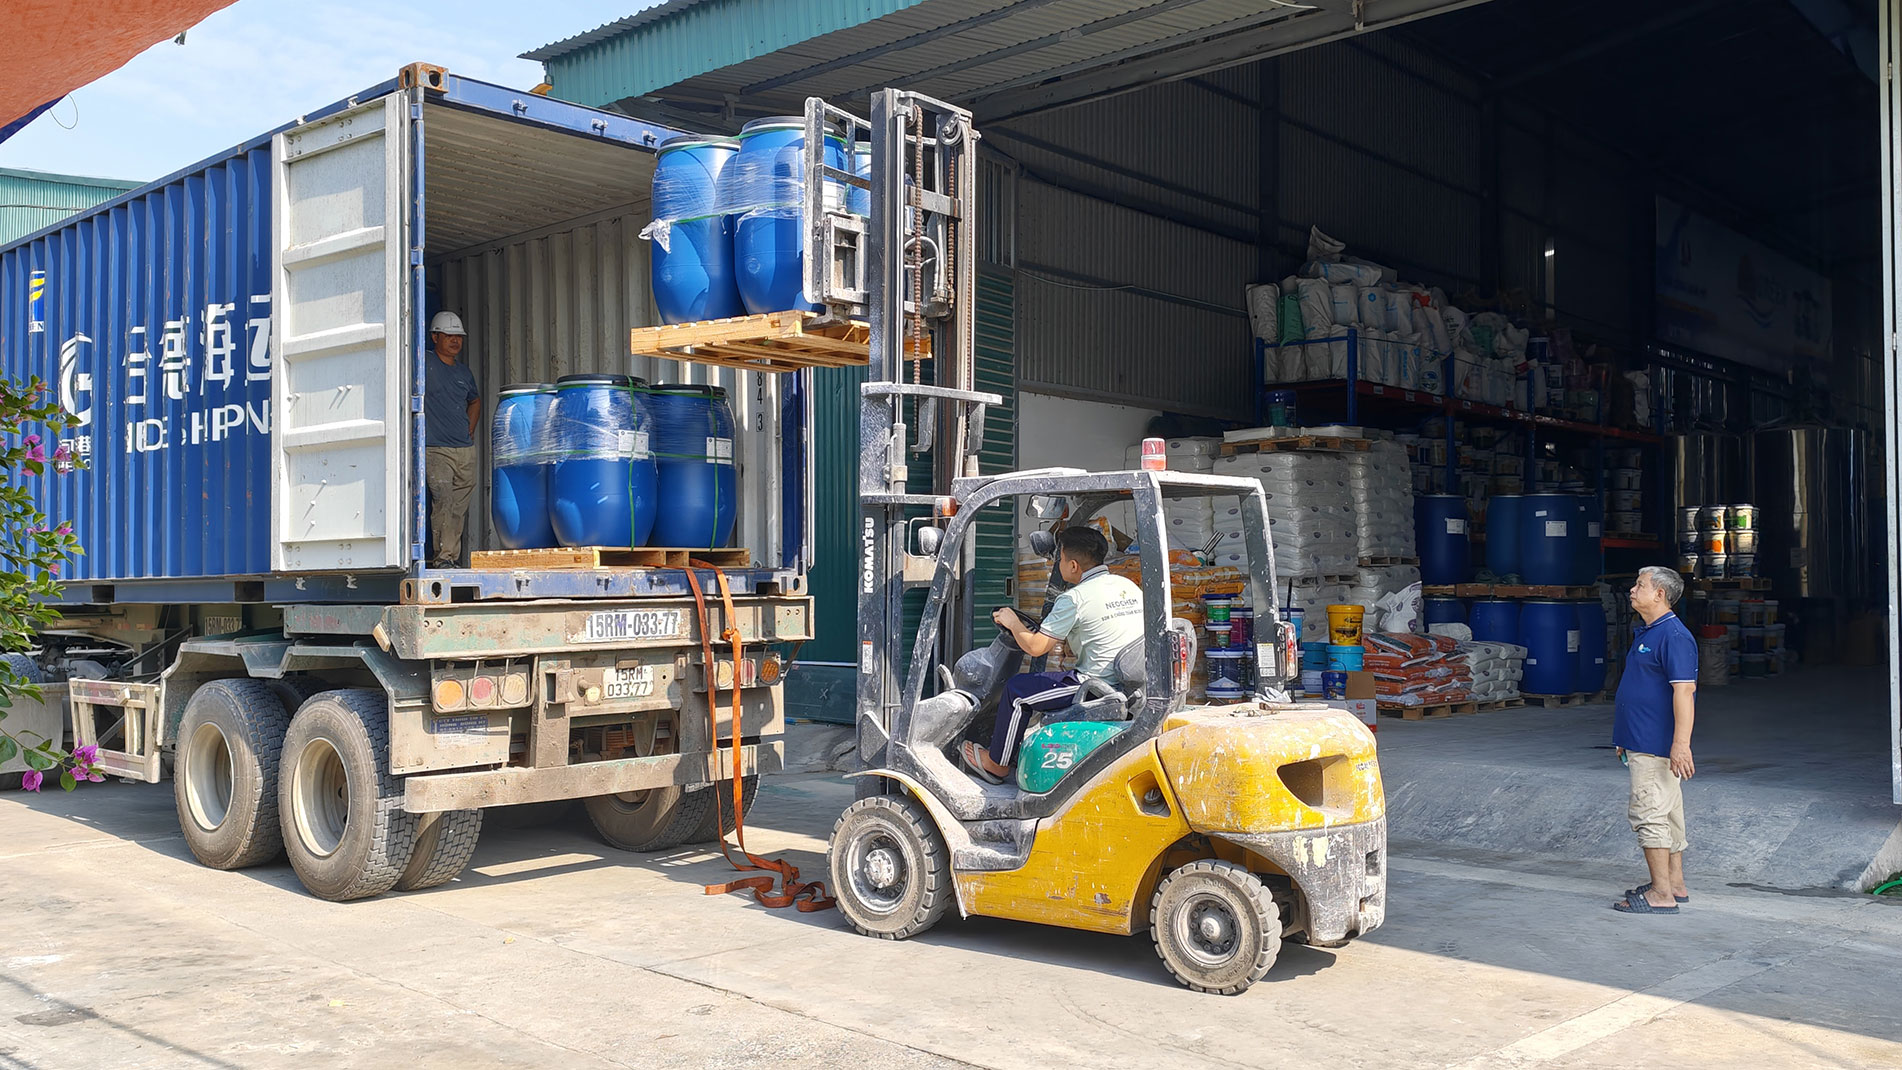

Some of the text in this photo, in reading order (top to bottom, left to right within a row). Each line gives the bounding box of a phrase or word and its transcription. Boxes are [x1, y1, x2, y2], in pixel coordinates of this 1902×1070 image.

[862, 517, 875, 594] KOMATSU
[1105, 599, 1138, 610] NEOCHEM
[587, 612, 678, 638] 15RM-033.77
[607, 681, 648, 697] 033.77
[1041, 752, 1073, 769] 25
